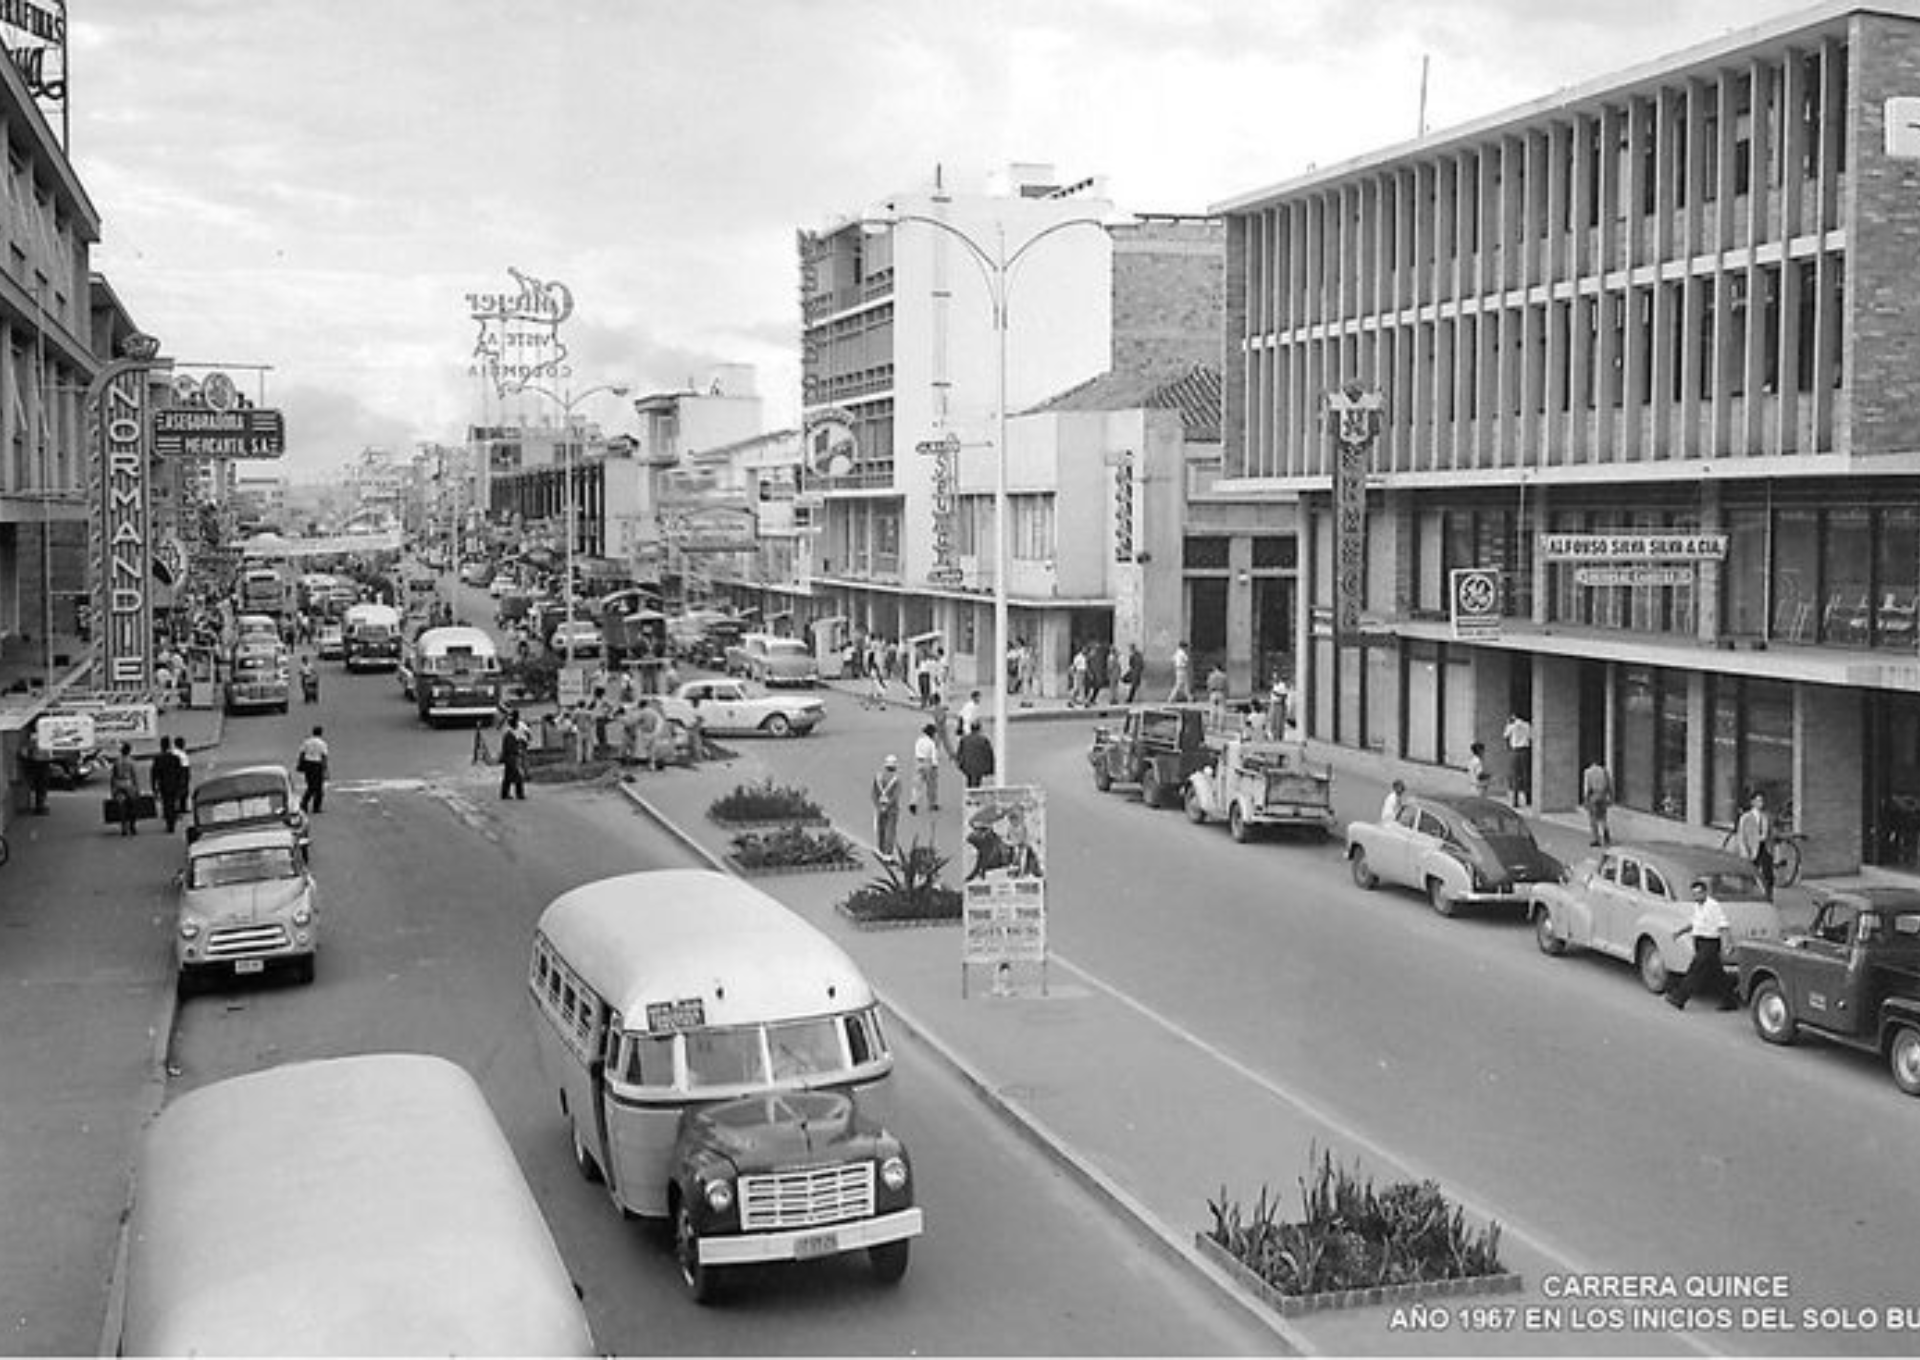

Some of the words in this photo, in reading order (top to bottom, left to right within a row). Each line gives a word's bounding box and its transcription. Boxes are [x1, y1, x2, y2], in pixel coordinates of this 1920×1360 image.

[165, 412, 245, 431] ASEGURADORA
[109, 384, 143, 681] NORMANDIE
[1548, 539, 1608, 555] ALFONSO
[1611, 539, 1646, 554] SILVA
[1650, 539, 1684, 554] SILVA
